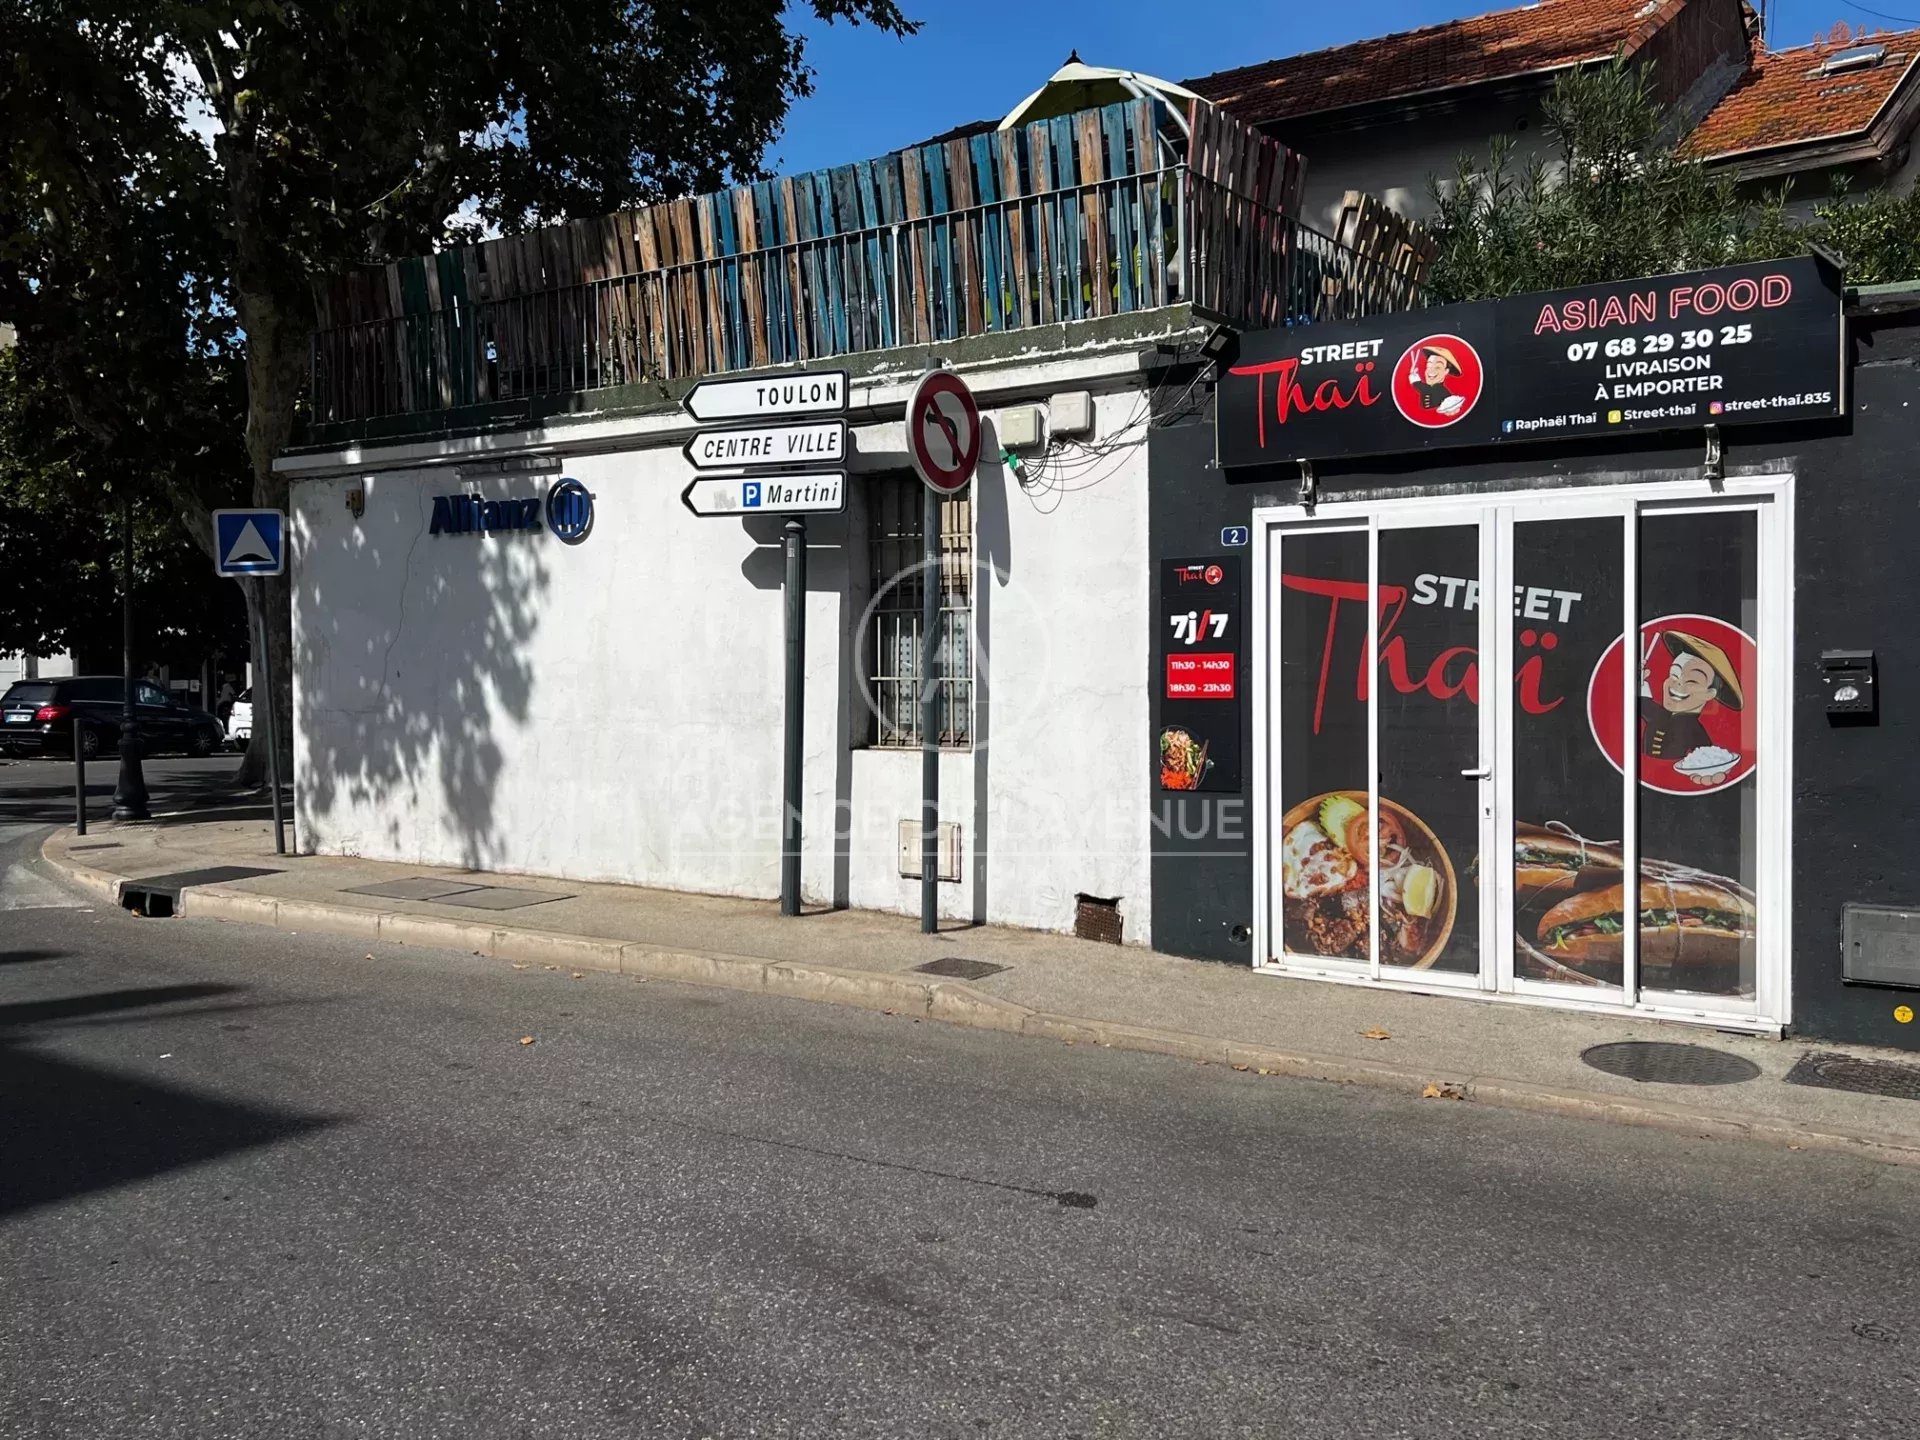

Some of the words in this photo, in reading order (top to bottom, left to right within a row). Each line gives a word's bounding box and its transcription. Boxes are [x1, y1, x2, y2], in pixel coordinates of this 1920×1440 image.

[1534, 291, 1656, 335] ASIAN
[1669, 275, 1792, 319] FOOD
[1301, 338, 1383, 365] STREET
[1567, 342, 1599, 361] 07
[1605, 338, 1636, 358] 68
[1643, 333, 1674, 354] 29
[1681, 329, 1713, 349] 30
[1720, 324, 1752, 345] 25
[1605, 354, 1711, 379] LIVRAISON
[757, 382, 837, 407] TOULON
[1594, 383, 1610, 401] À
[1613, 375, 1723, 399] EMPORTER
[1229, 357, 1382, 448] Thaï
[1624, 403, 1696, 421] Street-thaï
[1724, 391, 1831, 413] street-thaï.835
[1516, 414, 1567, 433] Raphaël
[1569, 412, 1597, 427] Thaï
[704, 436, 772, 459] CENTRE
[788, 432, 838, 453] VILLE
[746, 486, 758, 503] P
[767, 482, 838, 504] Martini
[1231, 529, 1239, 543] 2
[1170, 609, 1229, 645] 7j/7
[1171, 661, 1196, 670] 11h30
[1202, 660, 1230, 670] 14h30
[1282, 573, 1565, 735] Thaï
[1169, 683, 1196, 692] 18h30
[1203, 683, 1231, 692] 23h30
